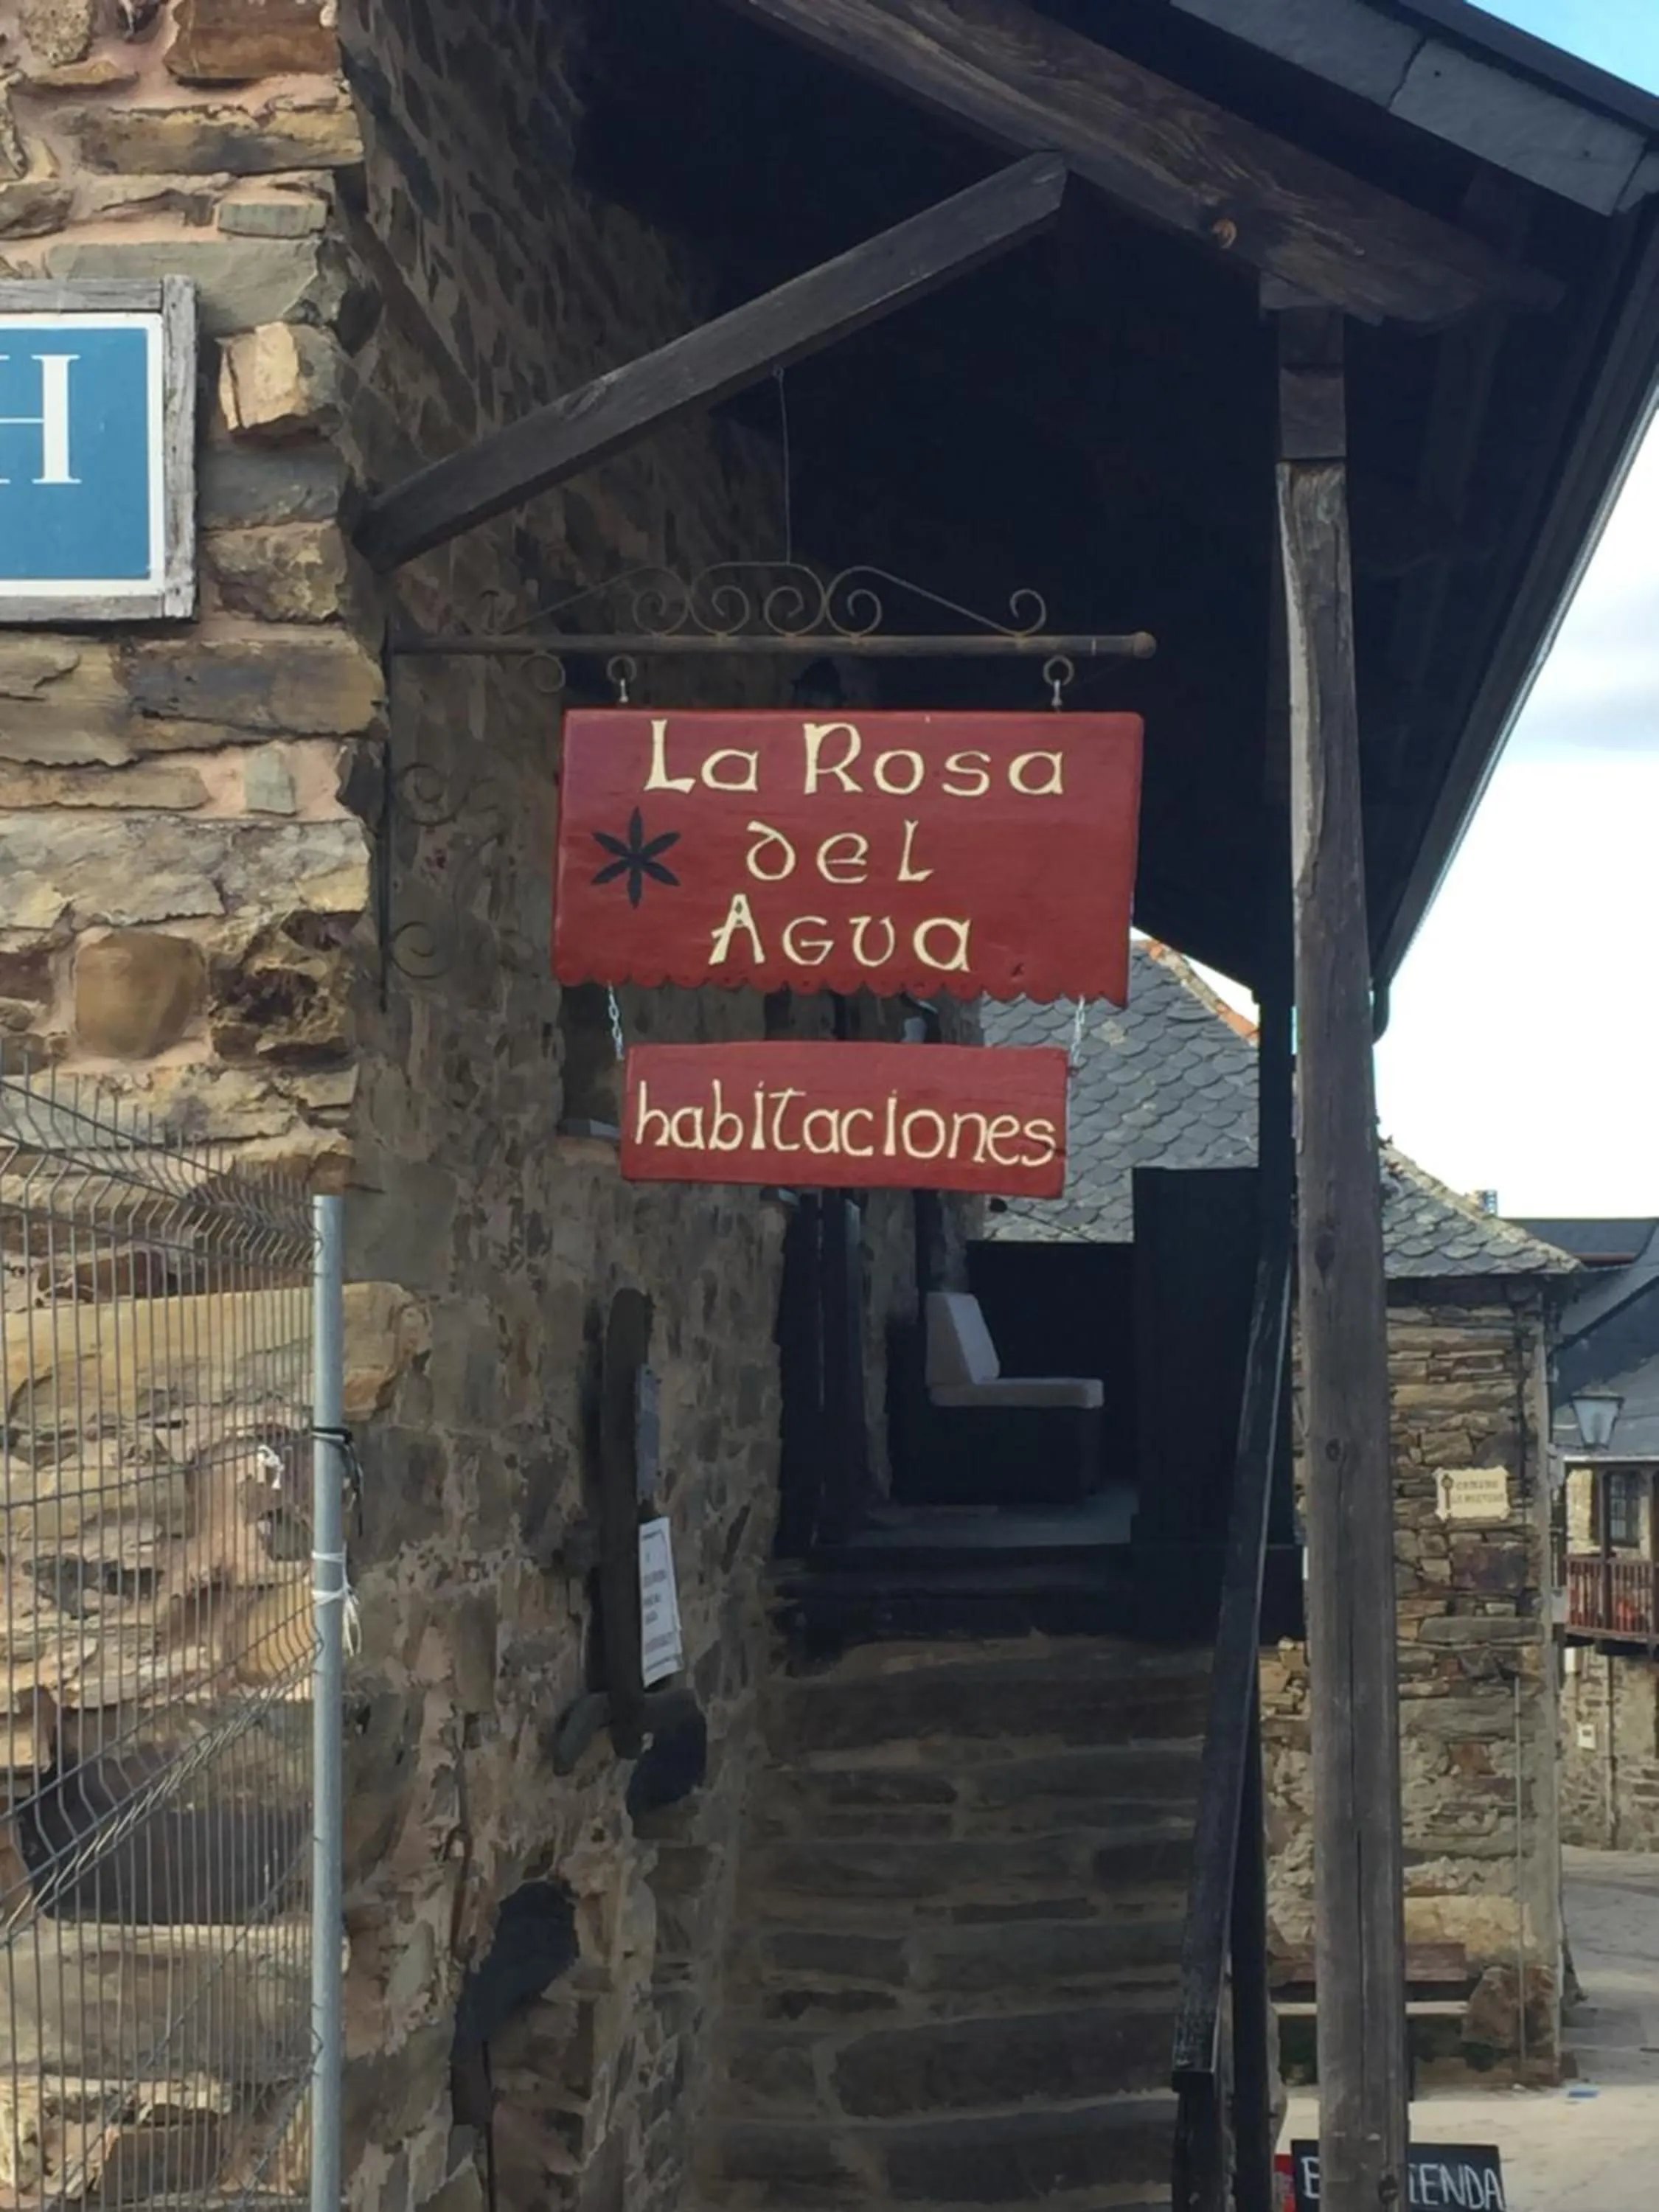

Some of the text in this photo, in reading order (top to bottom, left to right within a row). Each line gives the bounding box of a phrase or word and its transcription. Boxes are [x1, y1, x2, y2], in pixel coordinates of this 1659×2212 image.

[644, 719, 1064, 796] La Rosa
[635, 1079, 1056, 1166] habitaciones
[1408, 2163, 1507, 2211] IENDA
